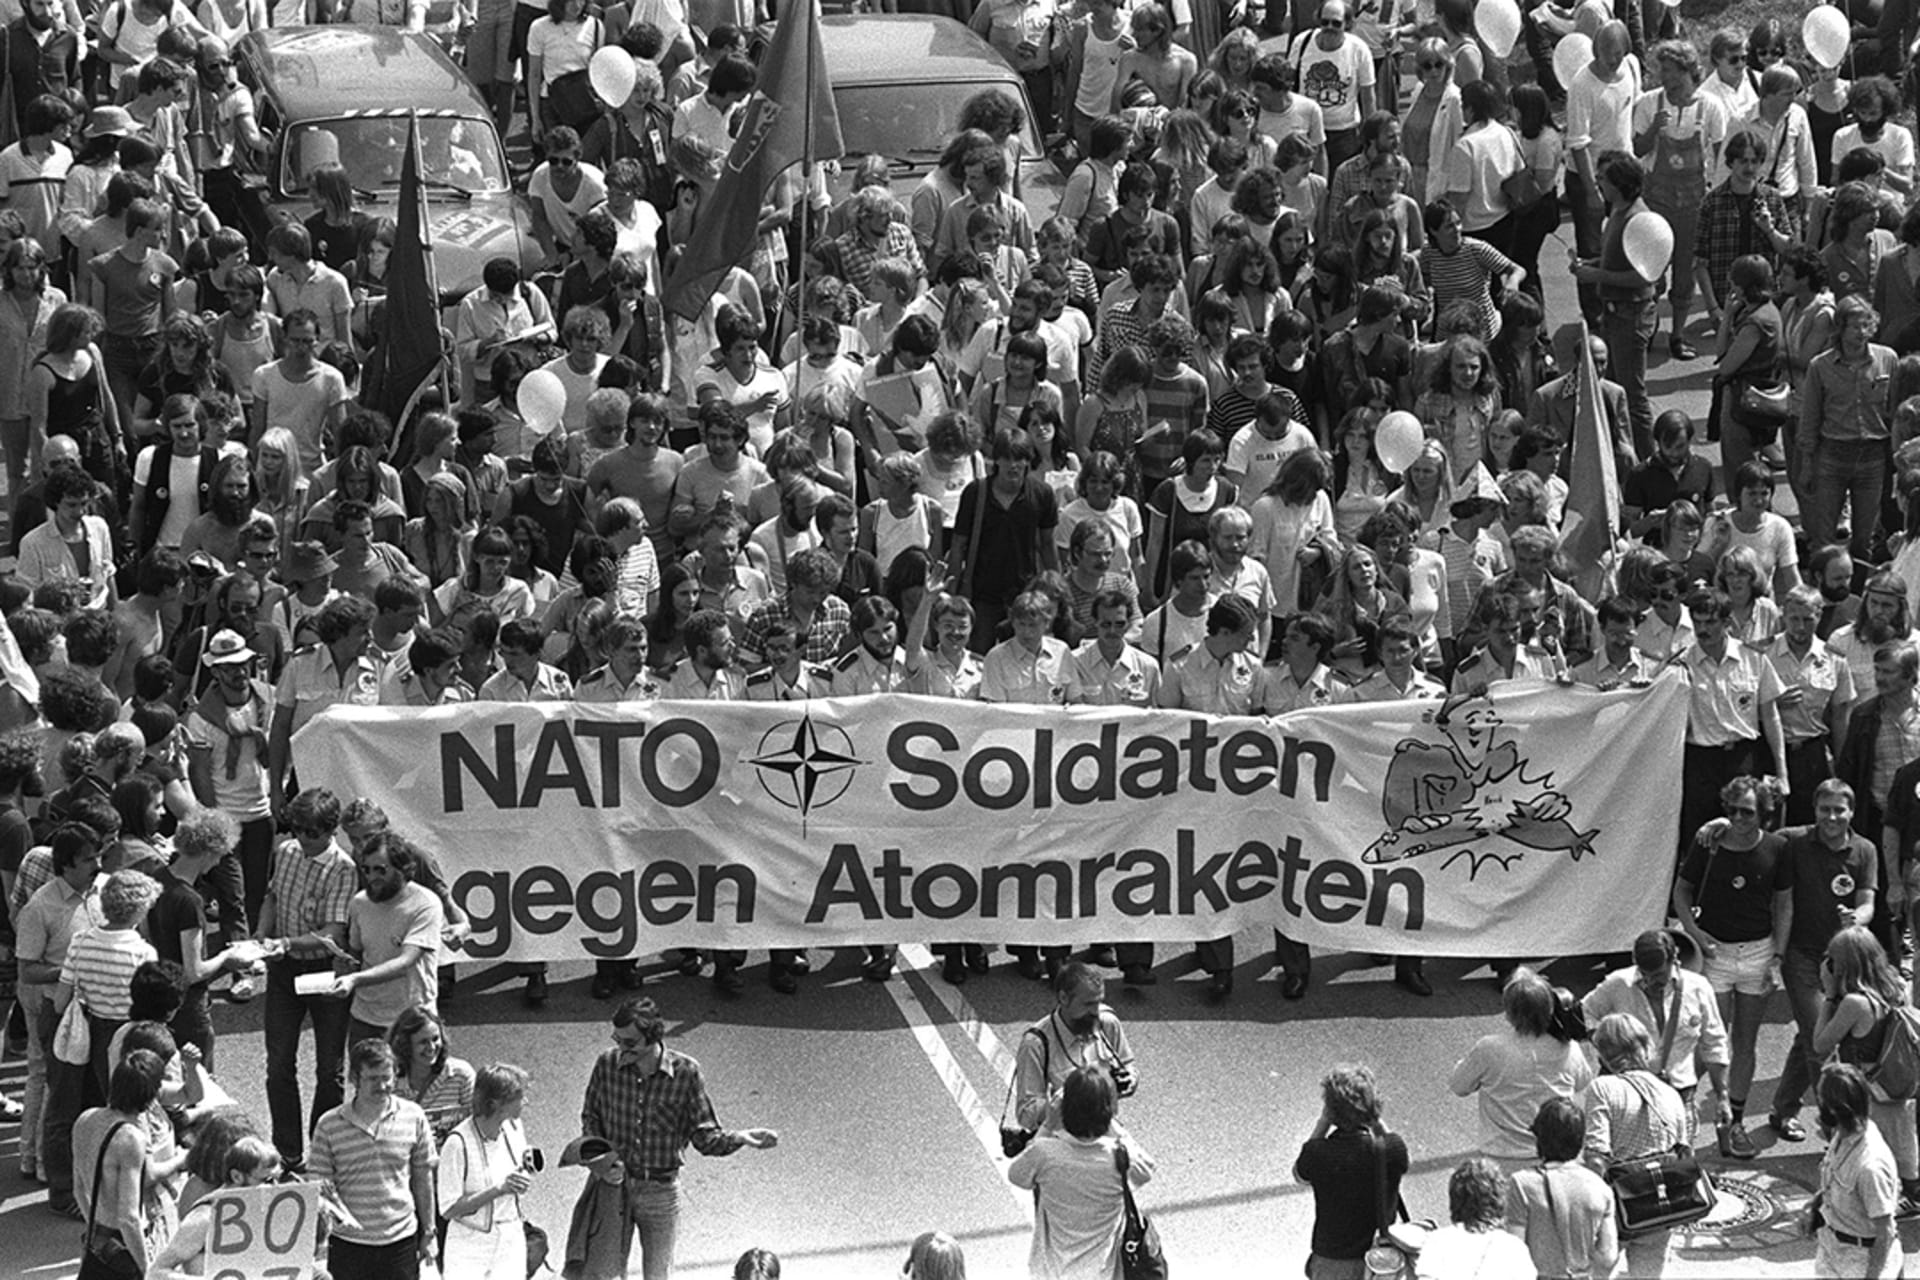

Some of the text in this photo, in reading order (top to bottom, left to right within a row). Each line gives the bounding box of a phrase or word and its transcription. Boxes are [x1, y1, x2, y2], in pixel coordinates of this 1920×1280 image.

[440, 718, 1337, 812] NATO Soldaten
[451, 829, 1425, 959] gegen Atomraketen
[212, 1190, 306, 1255] BO
